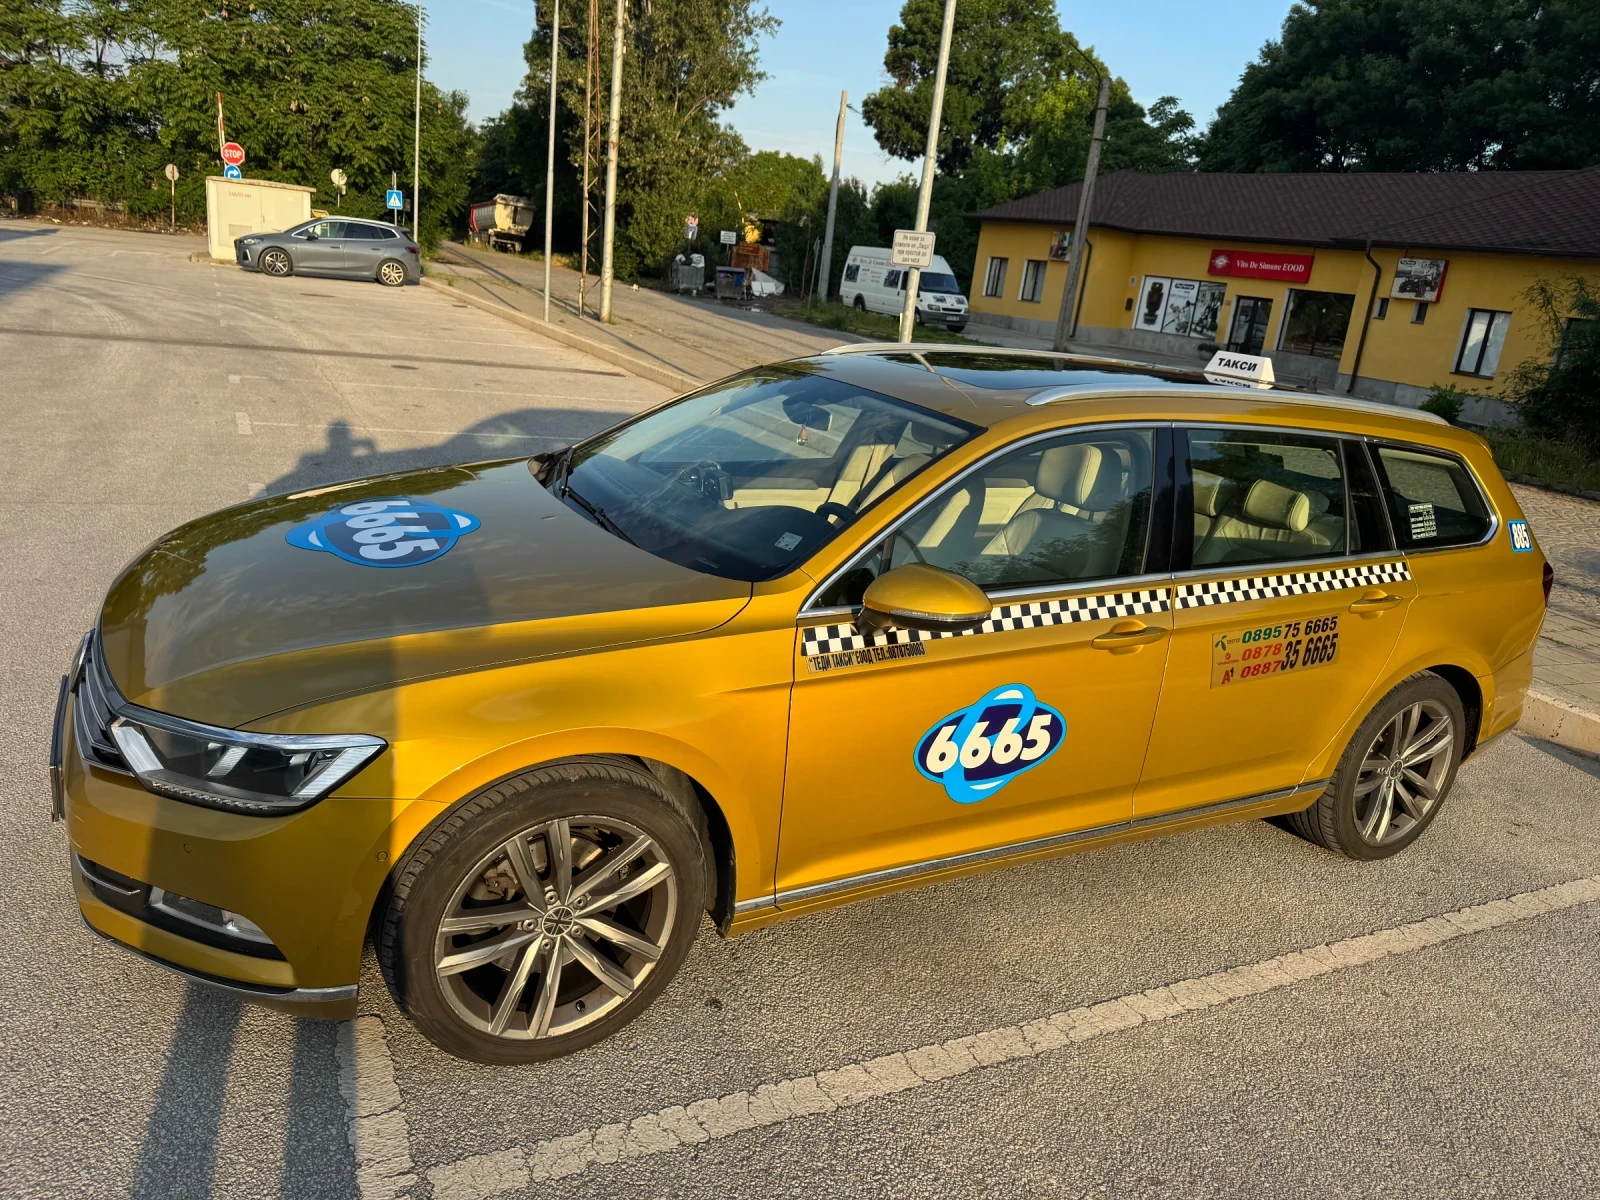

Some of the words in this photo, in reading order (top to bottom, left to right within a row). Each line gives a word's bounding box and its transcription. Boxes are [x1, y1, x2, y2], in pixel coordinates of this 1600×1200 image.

[224, 150, 241, 158] STOP
[1236, 260, 1249, 269] Vito
[1249, 261, 1259, 270] De
[1258, 262, 1282, 271] Simone
[1282, 263, 1305, 273] EOOD
[1218, 358, 1258, 372] ТАКСИ
[340, 501, 440, 560] 6665
[1511, 523, 1531, 549] 885
[1242, 626, 1283, 644] 0895
[1284, 622, 1302, 640] 75
[1305, 616, 1339, 636] 6665
[1242, 642, 1283, 662] 0878
[1281, 639, 1303, 671] 35
[1302, 633, 1340, 667] 6665
[1221, 667, 1235, 685] A1
[1240, 660, 1283, 679] 0887
[926, 714, 1052, 774] 6665
